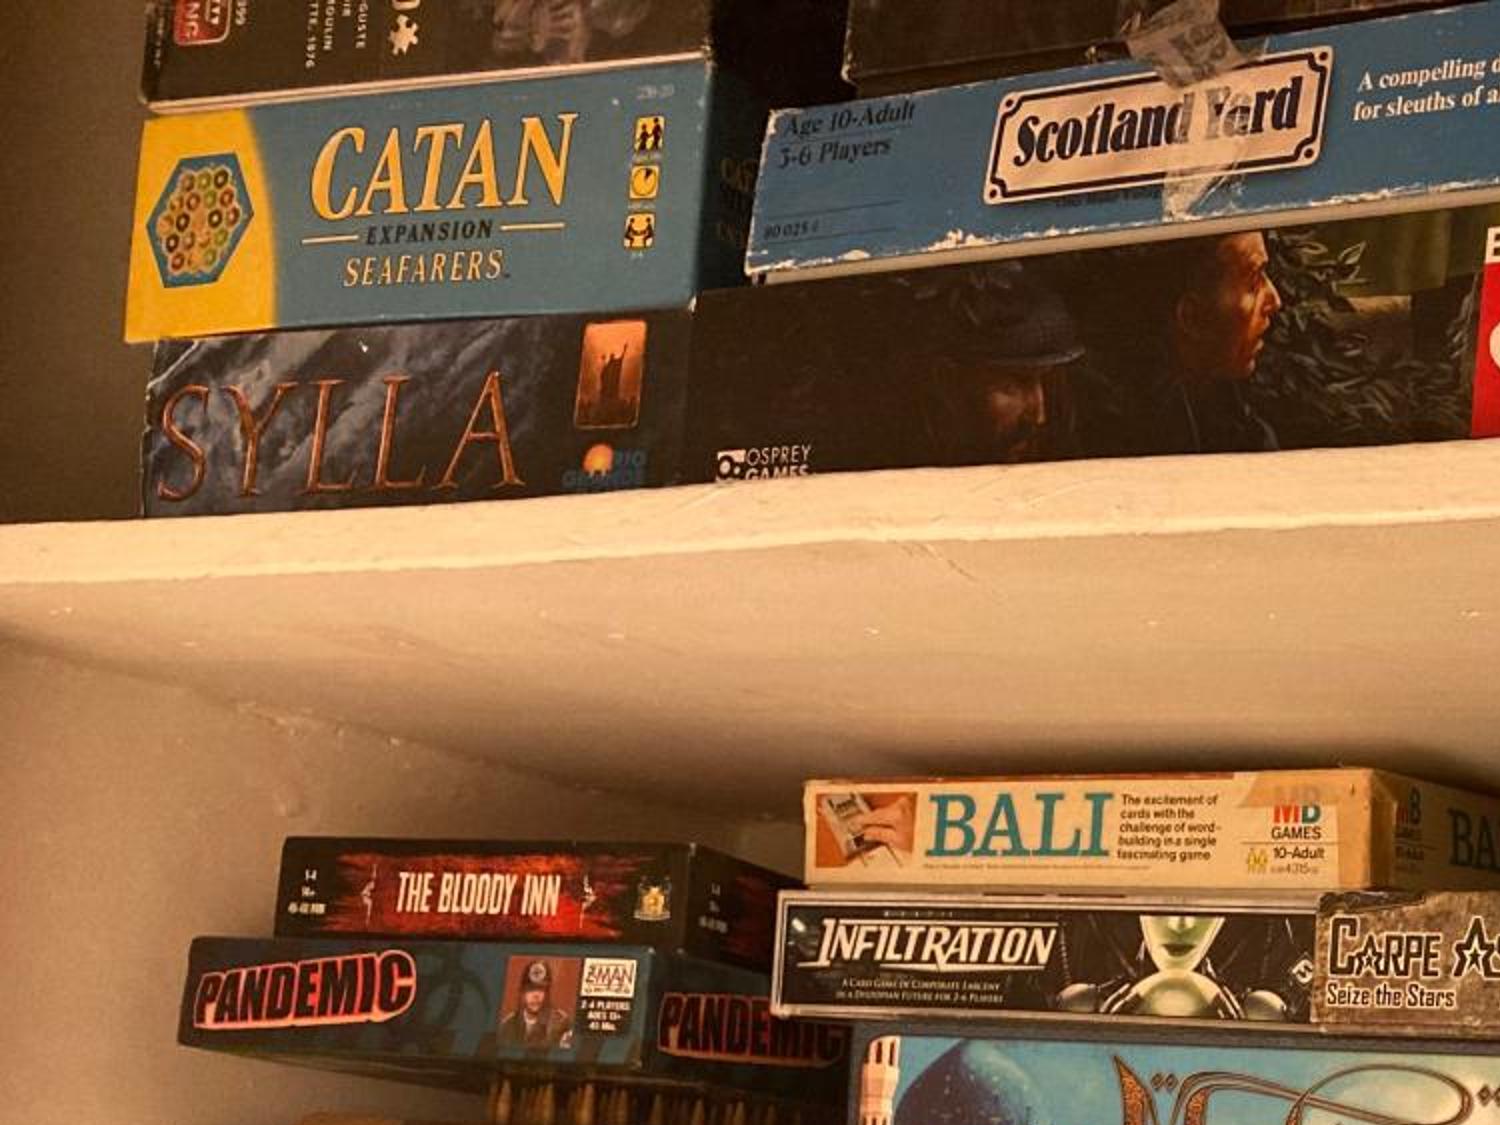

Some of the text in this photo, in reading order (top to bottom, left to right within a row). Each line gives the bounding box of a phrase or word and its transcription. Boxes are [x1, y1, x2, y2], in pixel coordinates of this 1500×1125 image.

[1357, 72, 1373, 92] A
[1379, 59, 1487, 87] compelling
[783, 100, 915, 139] Age 10-Adult
[1353, 101, 1382, 121] for
[1385, 94, 1456, 118] sleuths
[1462, 86, 1485, 108] of
[1013, 76, 1304, 167] Scotland Yard
[309, 112, 578, 221] CATAN
[817, 138, 892, 165] Players
[365, 219, 493, 246] EXPANSION
[343, 250, 505, 287] SEAFARERS
[156, 371, 526, 501] SYLLA
[747, 445, 812, 467] OSPREY
[1120, 807, 1195, 819] cards with the
[1122, 793, 1141, 806] The
[1206, 794, 1218, 806] of
[925, 792, 1114, 858] BALI
[1118, 834, 1161, 848] building
[1184, 834, 1217, 849] single
[1120, 821, 1172, 835] challenge
[1174, 821, 1186, 833] of
[1271, 826, 1322, 840] GAMES
[1117, 848, 1211, 863] fascinating game
[1273, 845, 1326, 859] 10-Adult
[396, 871, 562, 917] THE BLOODY INN
[798, 917, 1057, 967] INFILTRATION
[1328, 915, 1442, 979] CARPE
[193, 950, 417, 1029] PANDEMIC
[1327, 981, 1457, 1009] Seize the Stars
